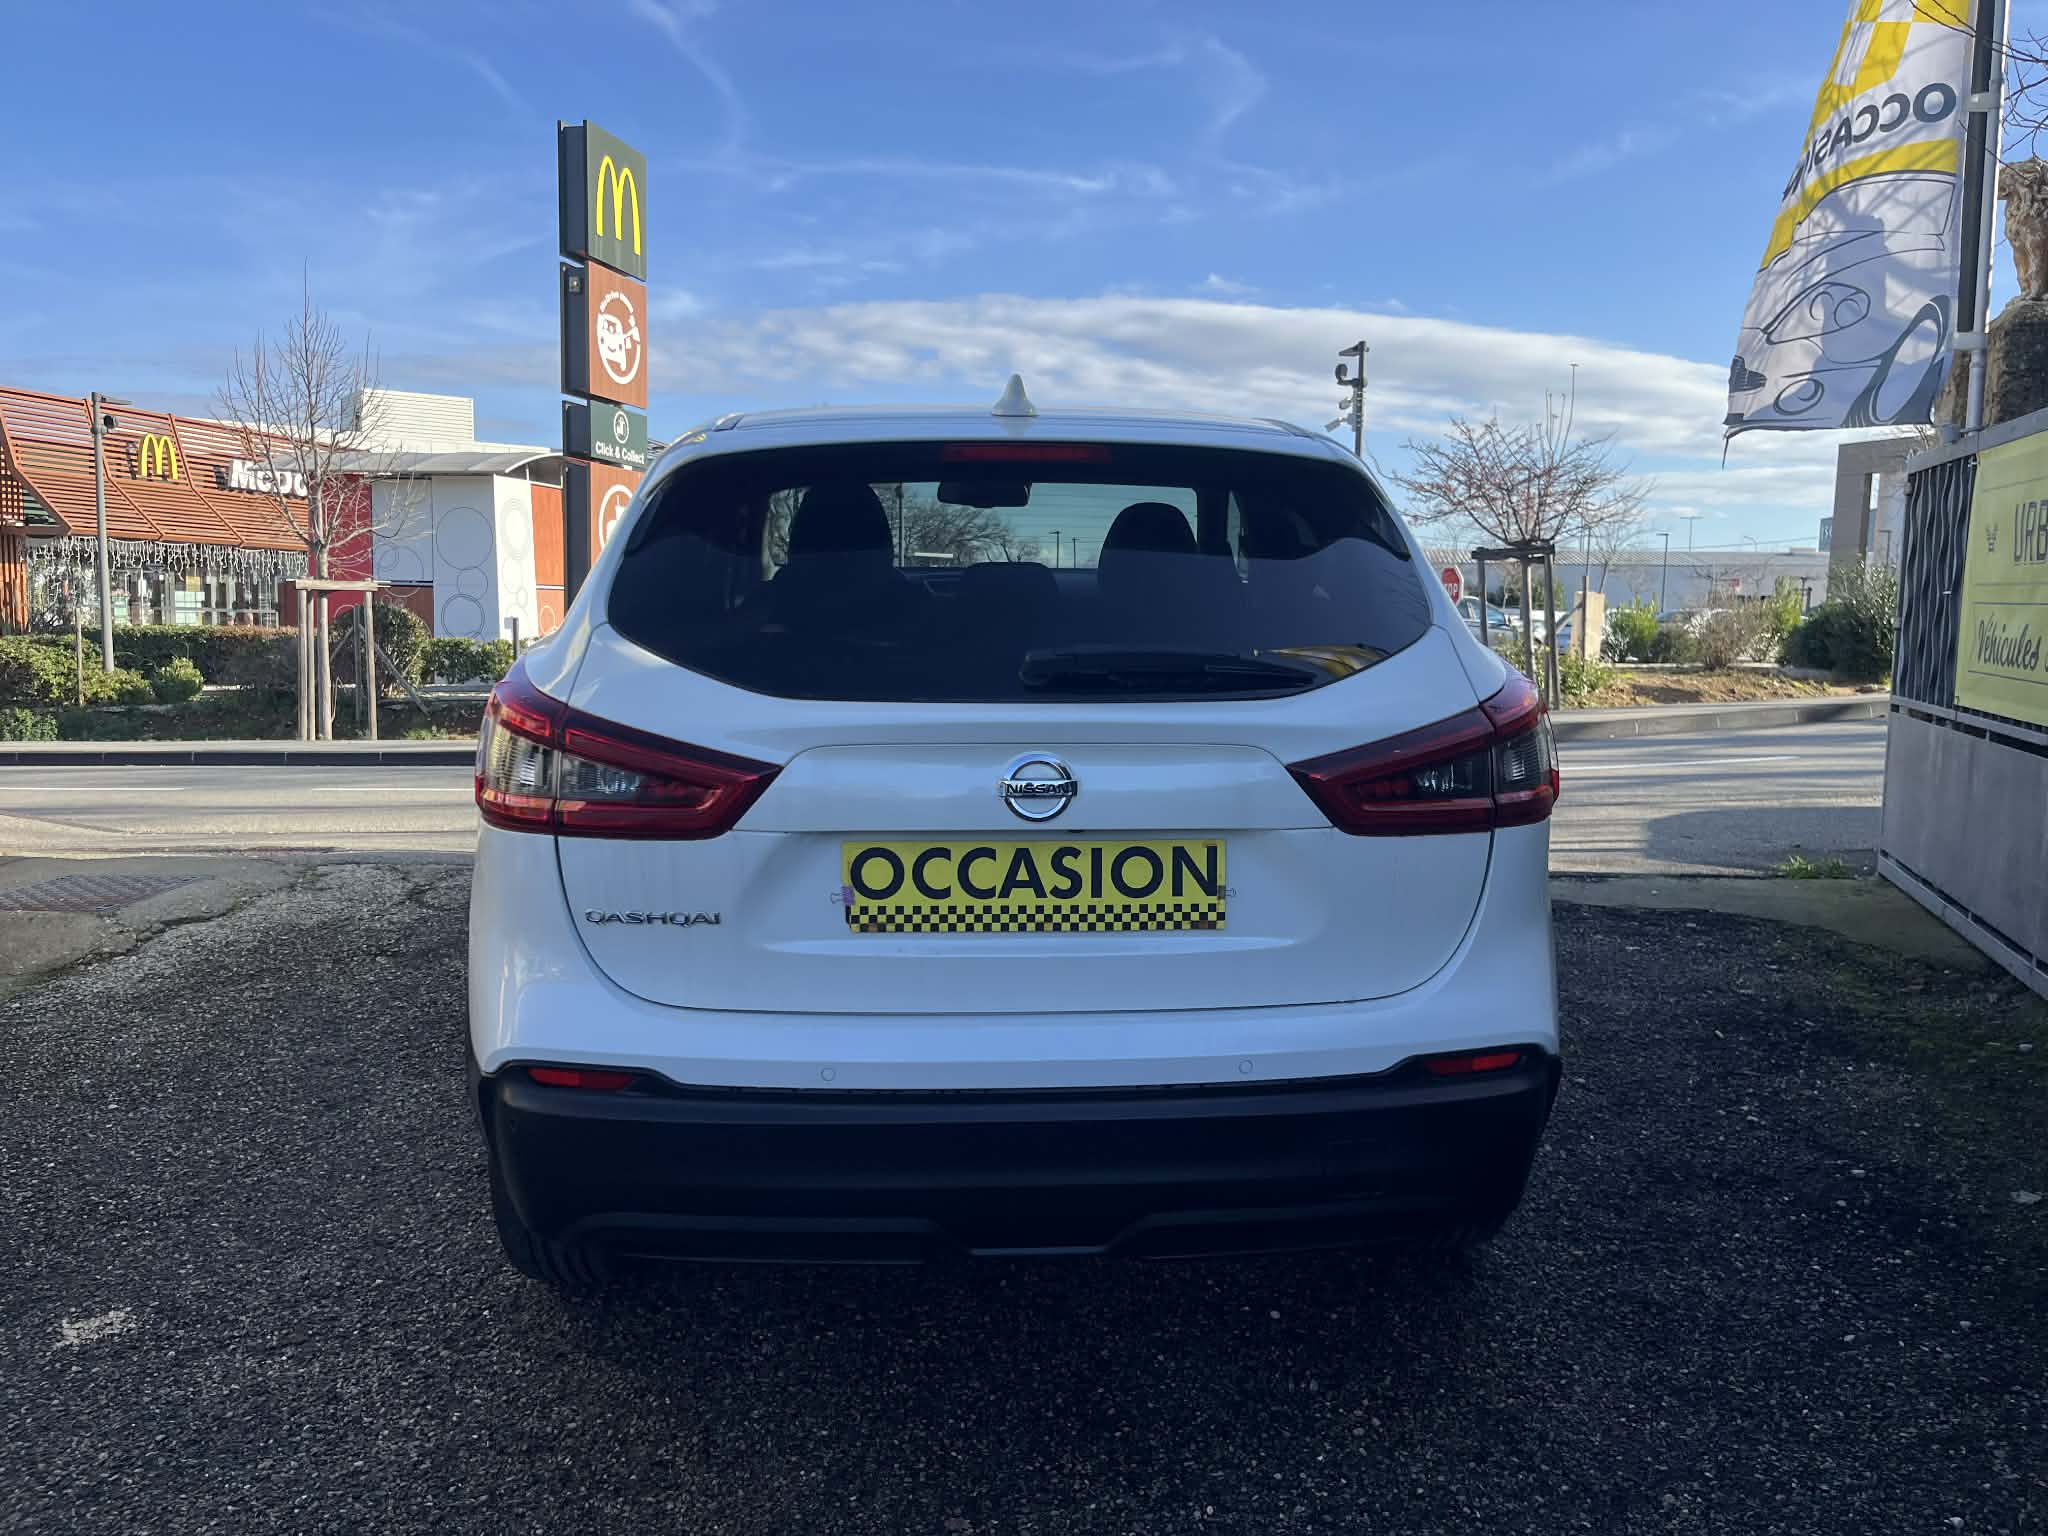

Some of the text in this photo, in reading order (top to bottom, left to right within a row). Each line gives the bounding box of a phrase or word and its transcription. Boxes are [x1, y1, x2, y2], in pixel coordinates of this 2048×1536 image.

[595, 441, 614, 457] Click
[622, 447, 645, 465] Collect
[1978, 612, 2042, 671] Véhicules
[1006, 782, 1073, 795] NISSAN
[850, 845, 1218, 900] OCCASION
[585, 909, 721, 927] QASHQAI
